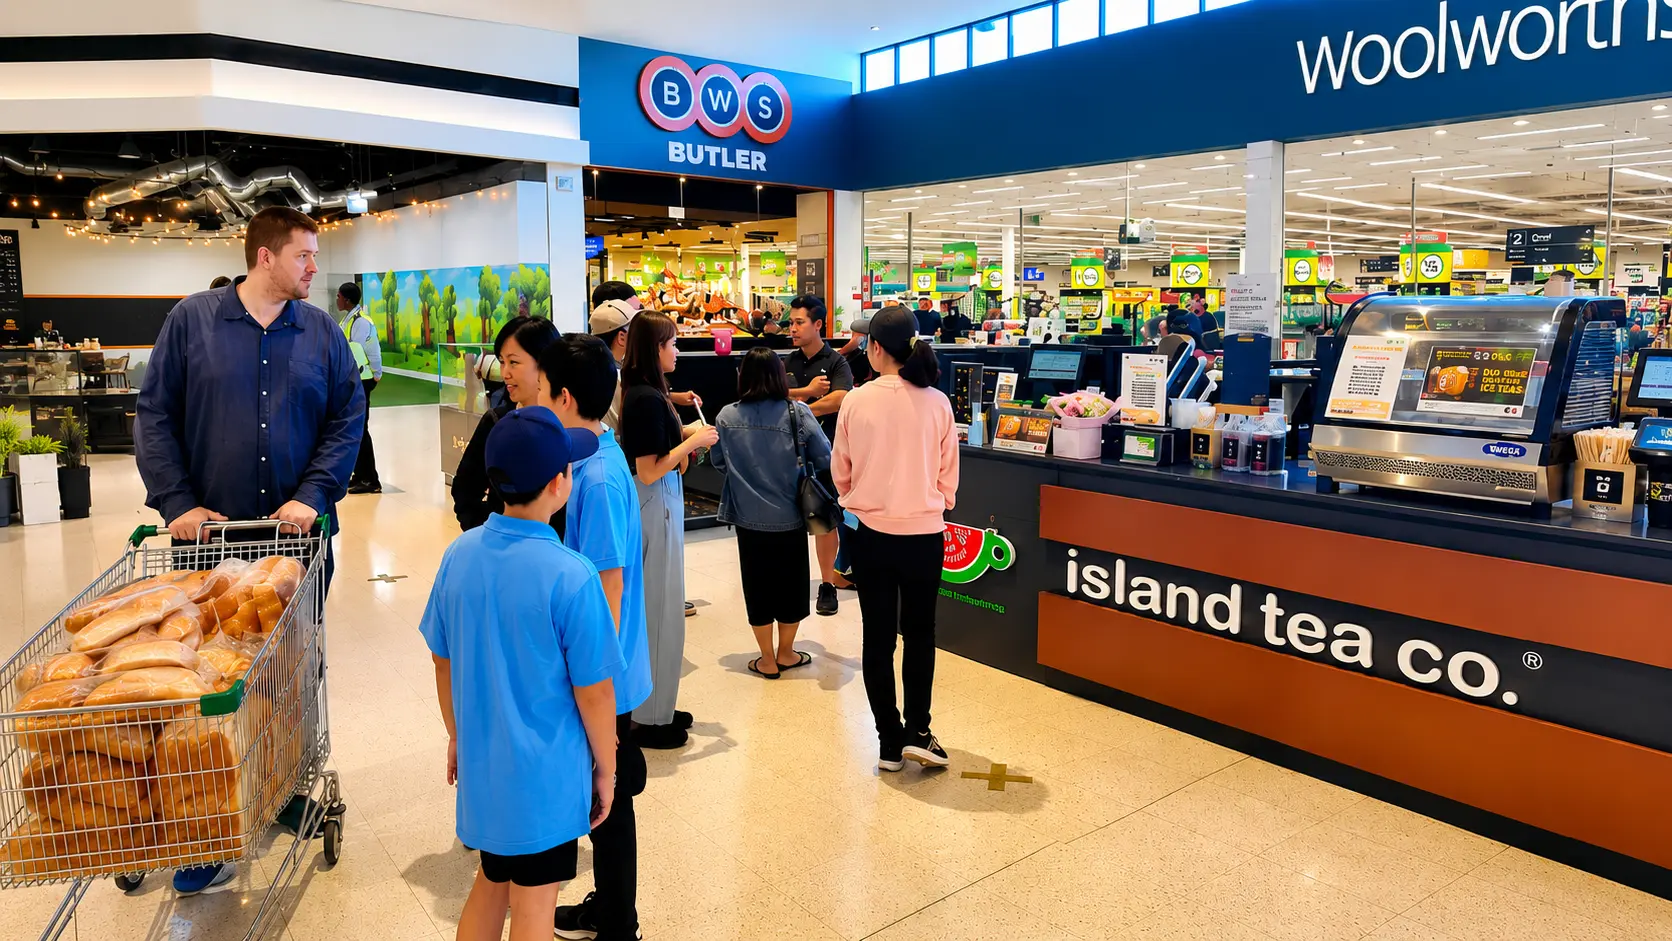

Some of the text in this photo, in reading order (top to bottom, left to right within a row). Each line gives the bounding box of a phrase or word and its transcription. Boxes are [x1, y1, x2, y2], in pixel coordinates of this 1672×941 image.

[663, 81, 773, 119] BWS
[668, 141, 767, 171] BUTLER
[1513, 233, 1522, 245] 2
[1065, 547, 1243, 635] island
[1260, 593, 1373, 668] tea
[1396, 638, 1520, 706] co.
